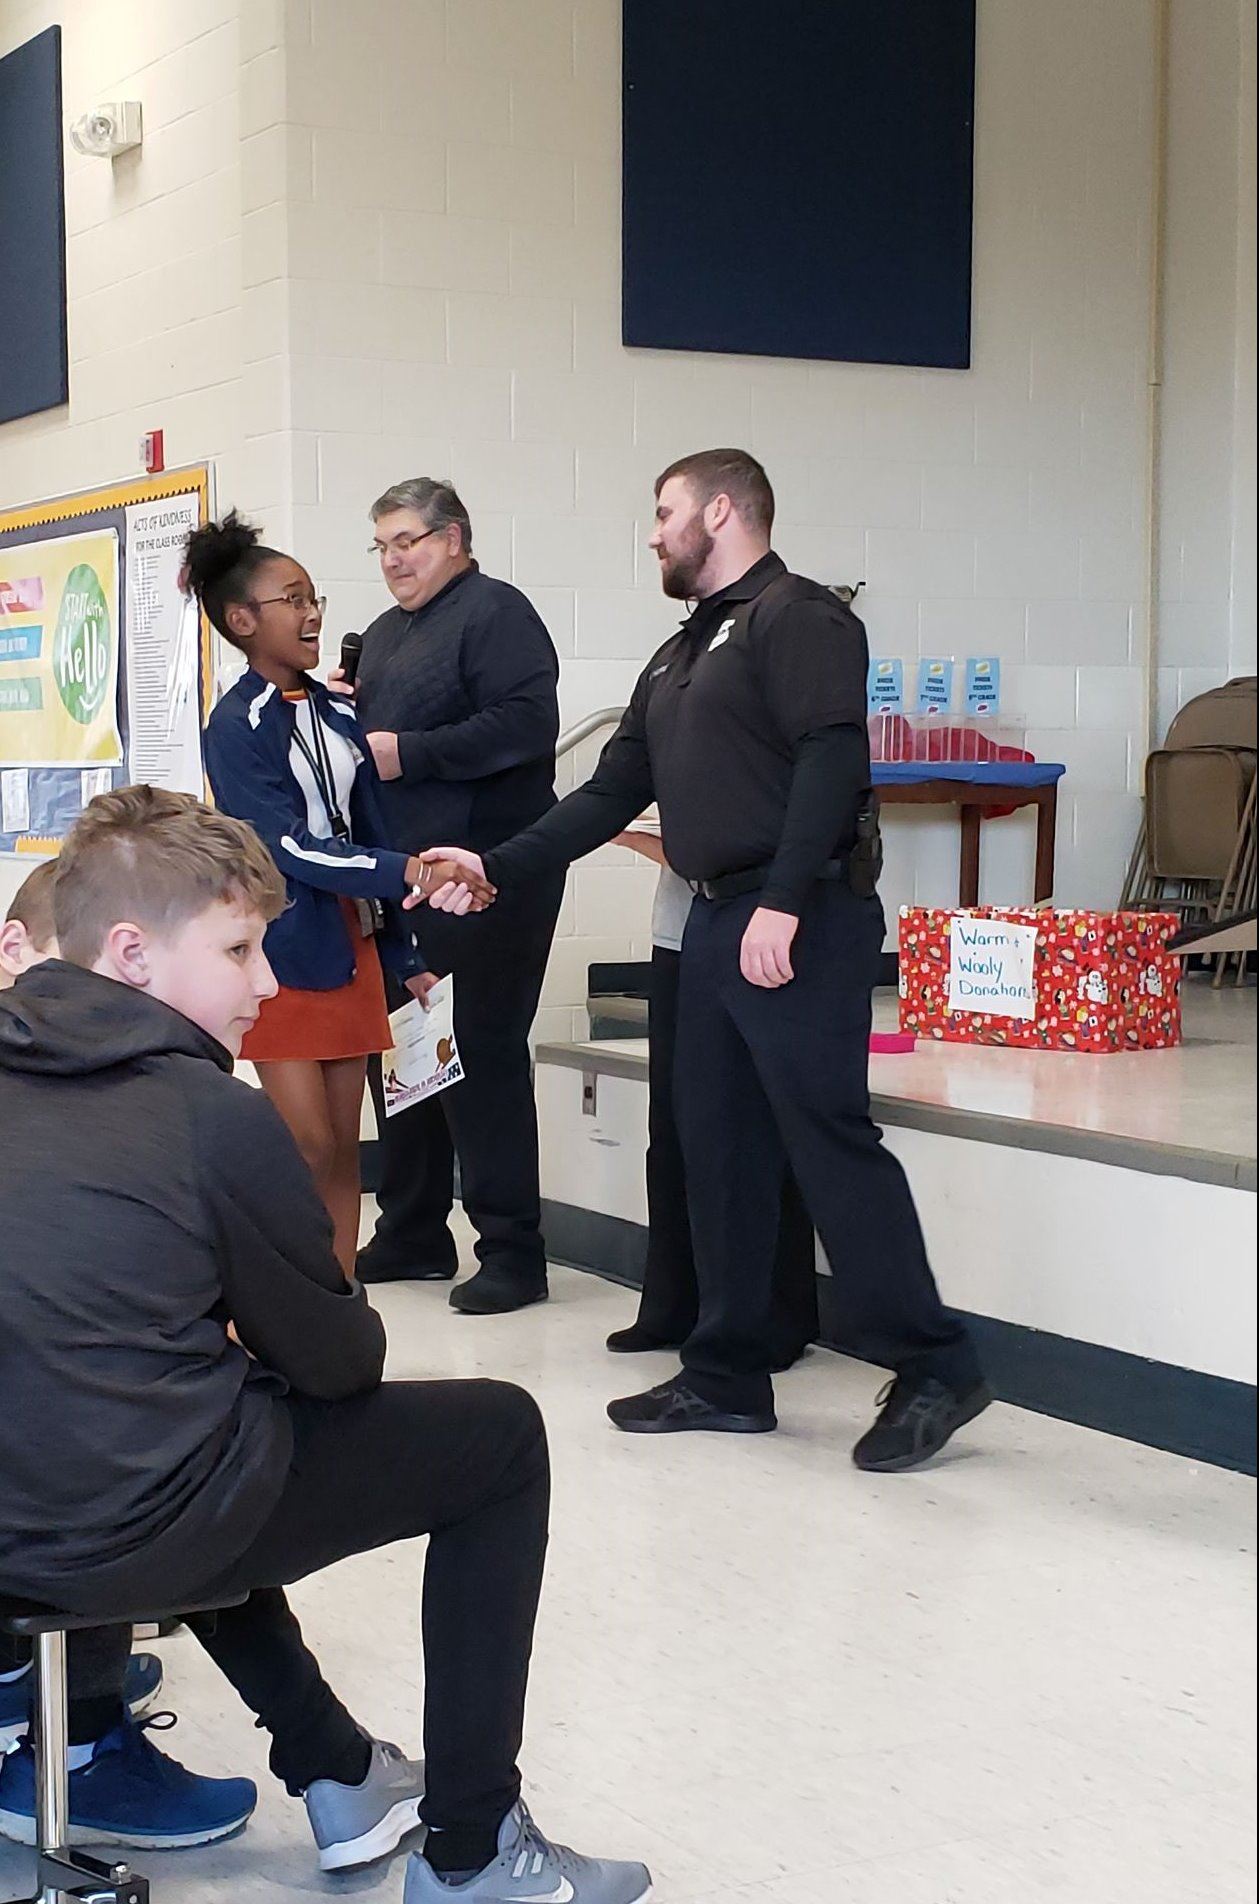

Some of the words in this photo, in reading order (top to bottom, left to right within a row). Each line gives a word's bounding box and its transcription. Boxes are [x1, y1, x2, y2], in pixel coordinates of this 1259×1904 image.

[65, 592, 89, 622] START
[87, 599, 104, 620] with
[60, 619, 107, 695] Hello
[958, 926, 1009, 946] Warm
[958, 956, 1003, 983] Wooly
